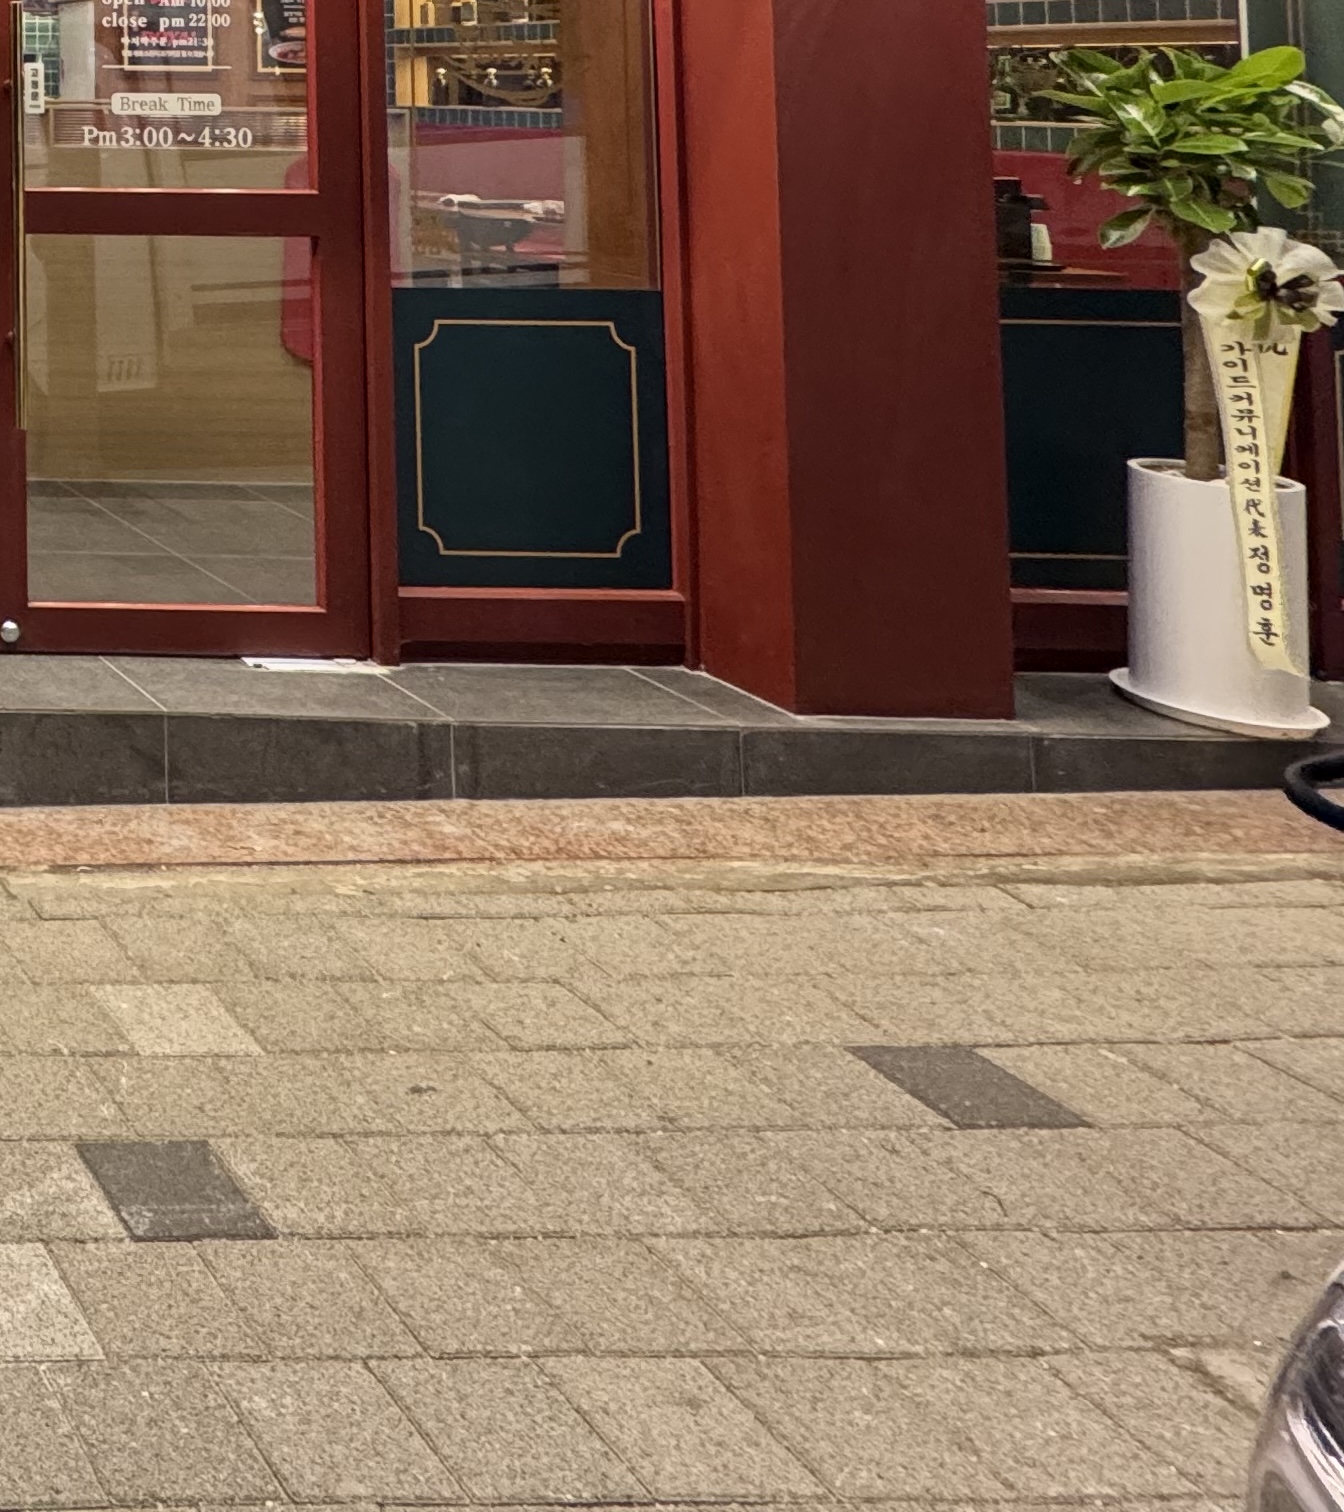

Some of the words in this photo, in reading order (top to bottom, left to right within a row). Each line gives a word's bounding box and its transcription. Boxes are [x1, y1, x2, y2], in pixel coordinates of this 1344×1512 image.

[101, 11, 148, 28] close
[159, 16, 185, 32] pm
[119, 95, 169, 112] Break
[176, 95, 215, 112] Time
